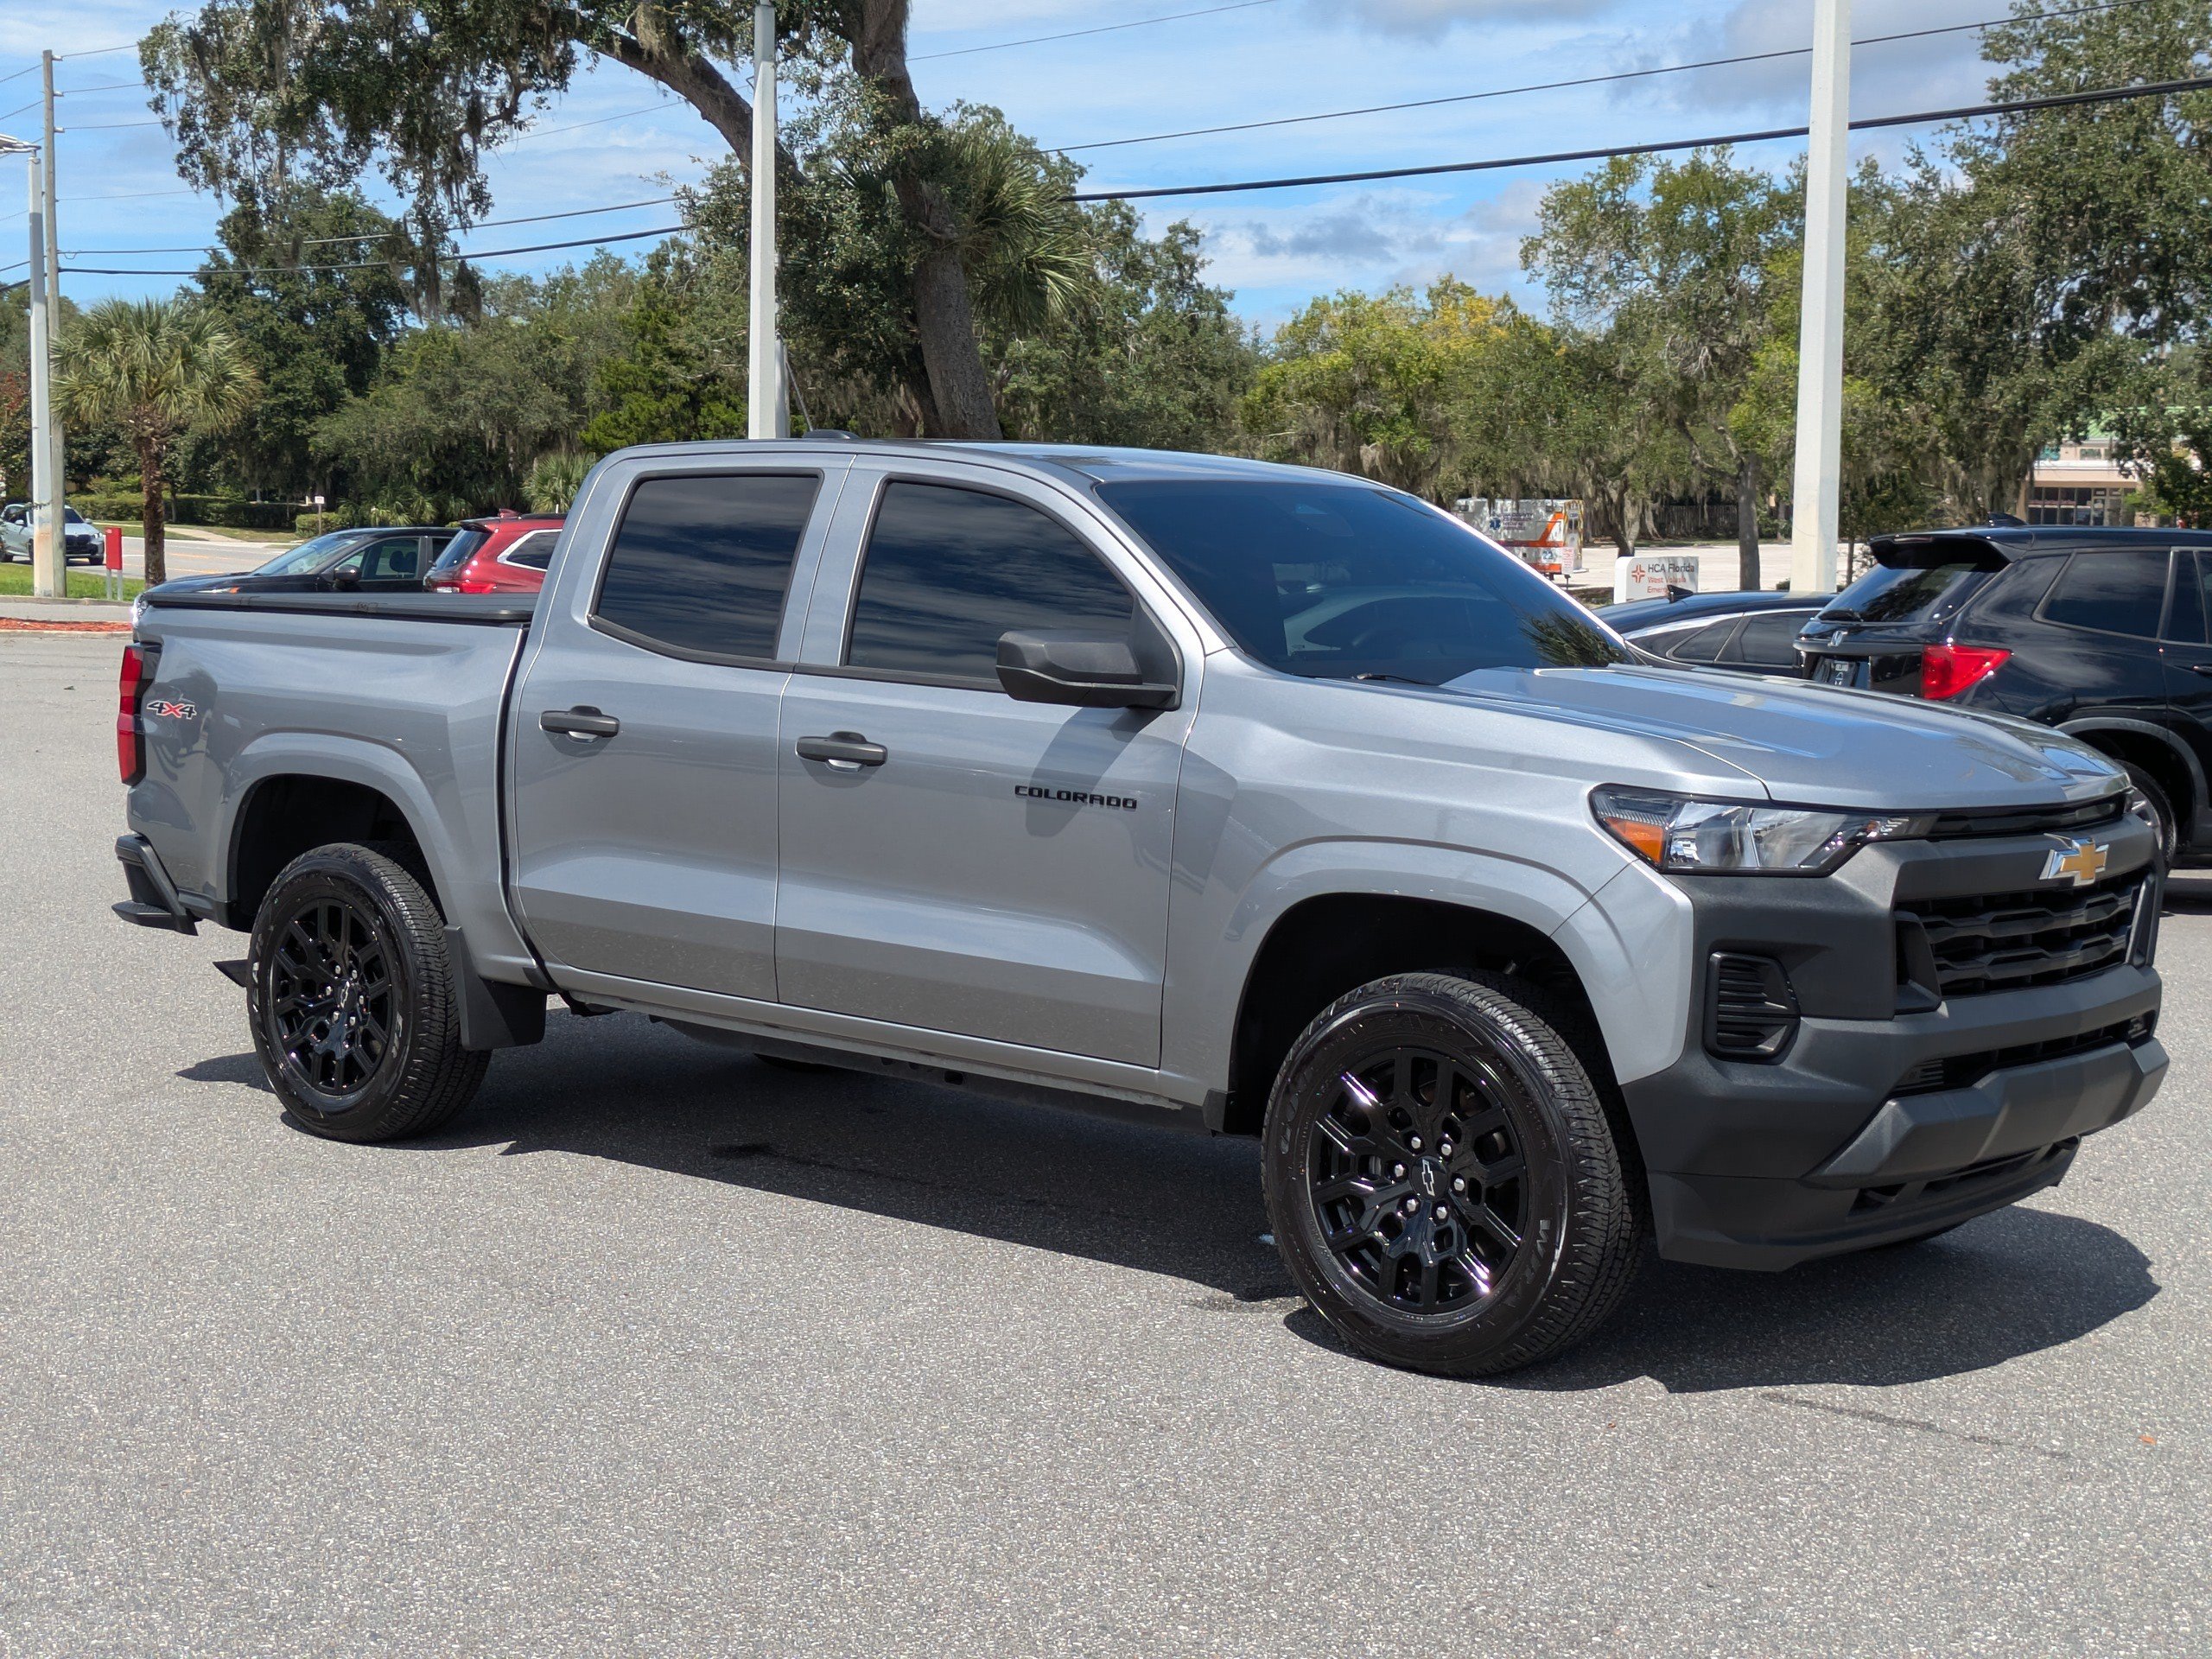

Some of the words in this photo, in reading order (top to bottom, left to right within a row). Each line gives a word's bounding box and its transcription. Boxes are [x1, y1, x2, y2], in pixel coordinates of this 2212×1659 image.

[1542, 550, 1554, 560] 22
[1648, 563, 1666, 573] HCA
[1668, 563, 1695, 573] Florida
[1647, 585, 1669, 594] Emerg
[1014, 785, 1138, 810] COLORADO
